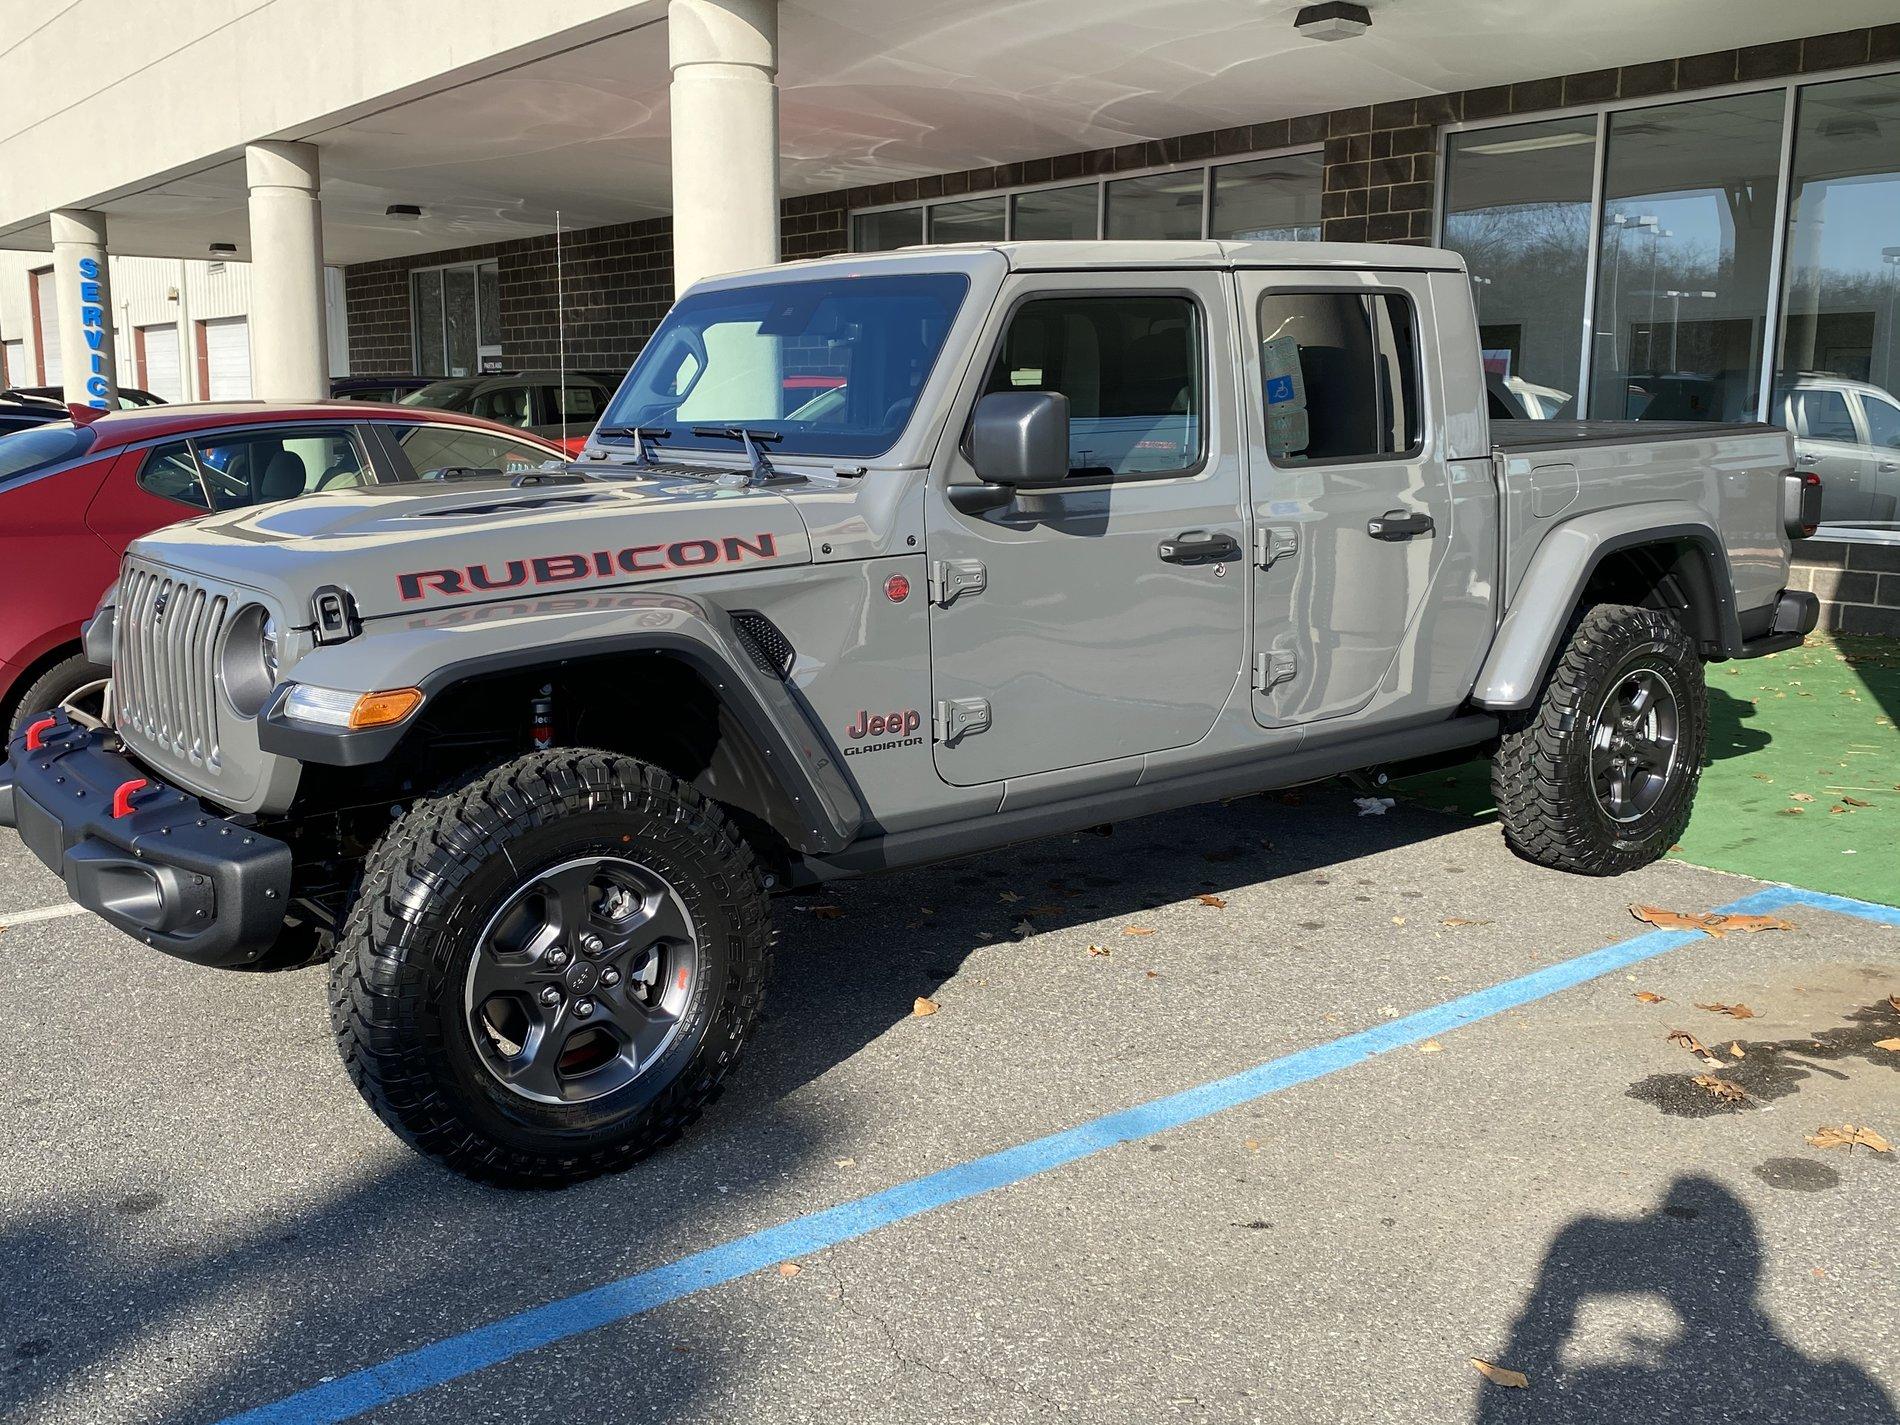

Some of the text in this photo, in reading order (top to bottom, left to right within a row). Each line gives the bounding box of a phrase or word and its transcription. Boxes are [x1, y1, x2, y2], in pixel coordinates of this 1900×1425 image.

[395, 533, 778, 601] RUBICON
[845, 709, 921, 740] Jeep
[843, 736, 923, 757] GLADIATOR
